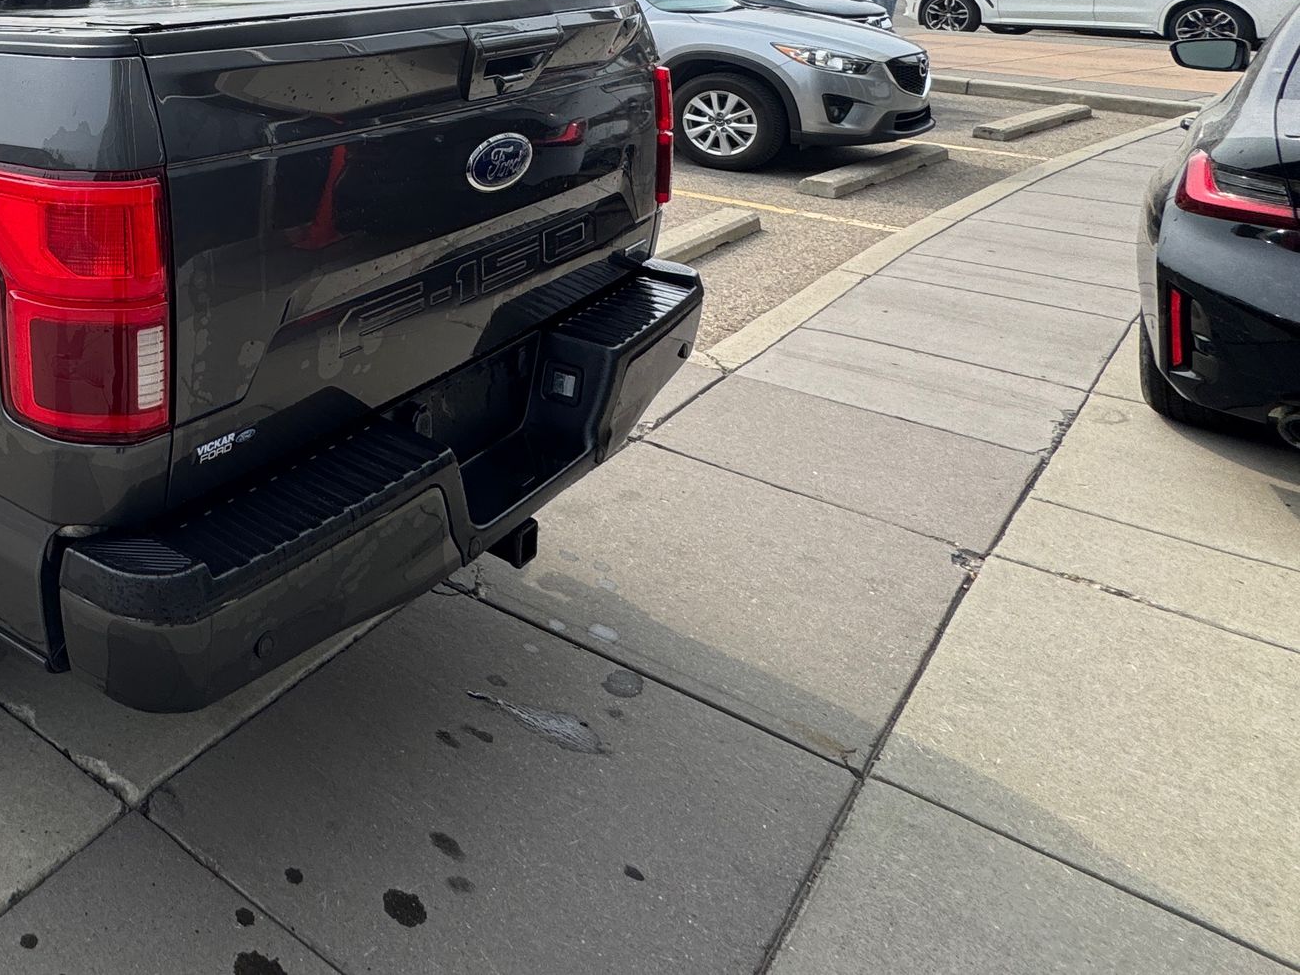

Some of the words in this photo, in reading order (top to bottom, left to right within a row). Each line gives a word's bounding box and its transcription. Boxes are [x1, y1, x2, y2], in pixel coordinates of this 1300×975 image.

[486, 145, 524, 181] Ford
[338, 212, 595, 359] F-150
[196, 432, 236, 456] VICKAR
[199, 443, 233, 464] FORD
